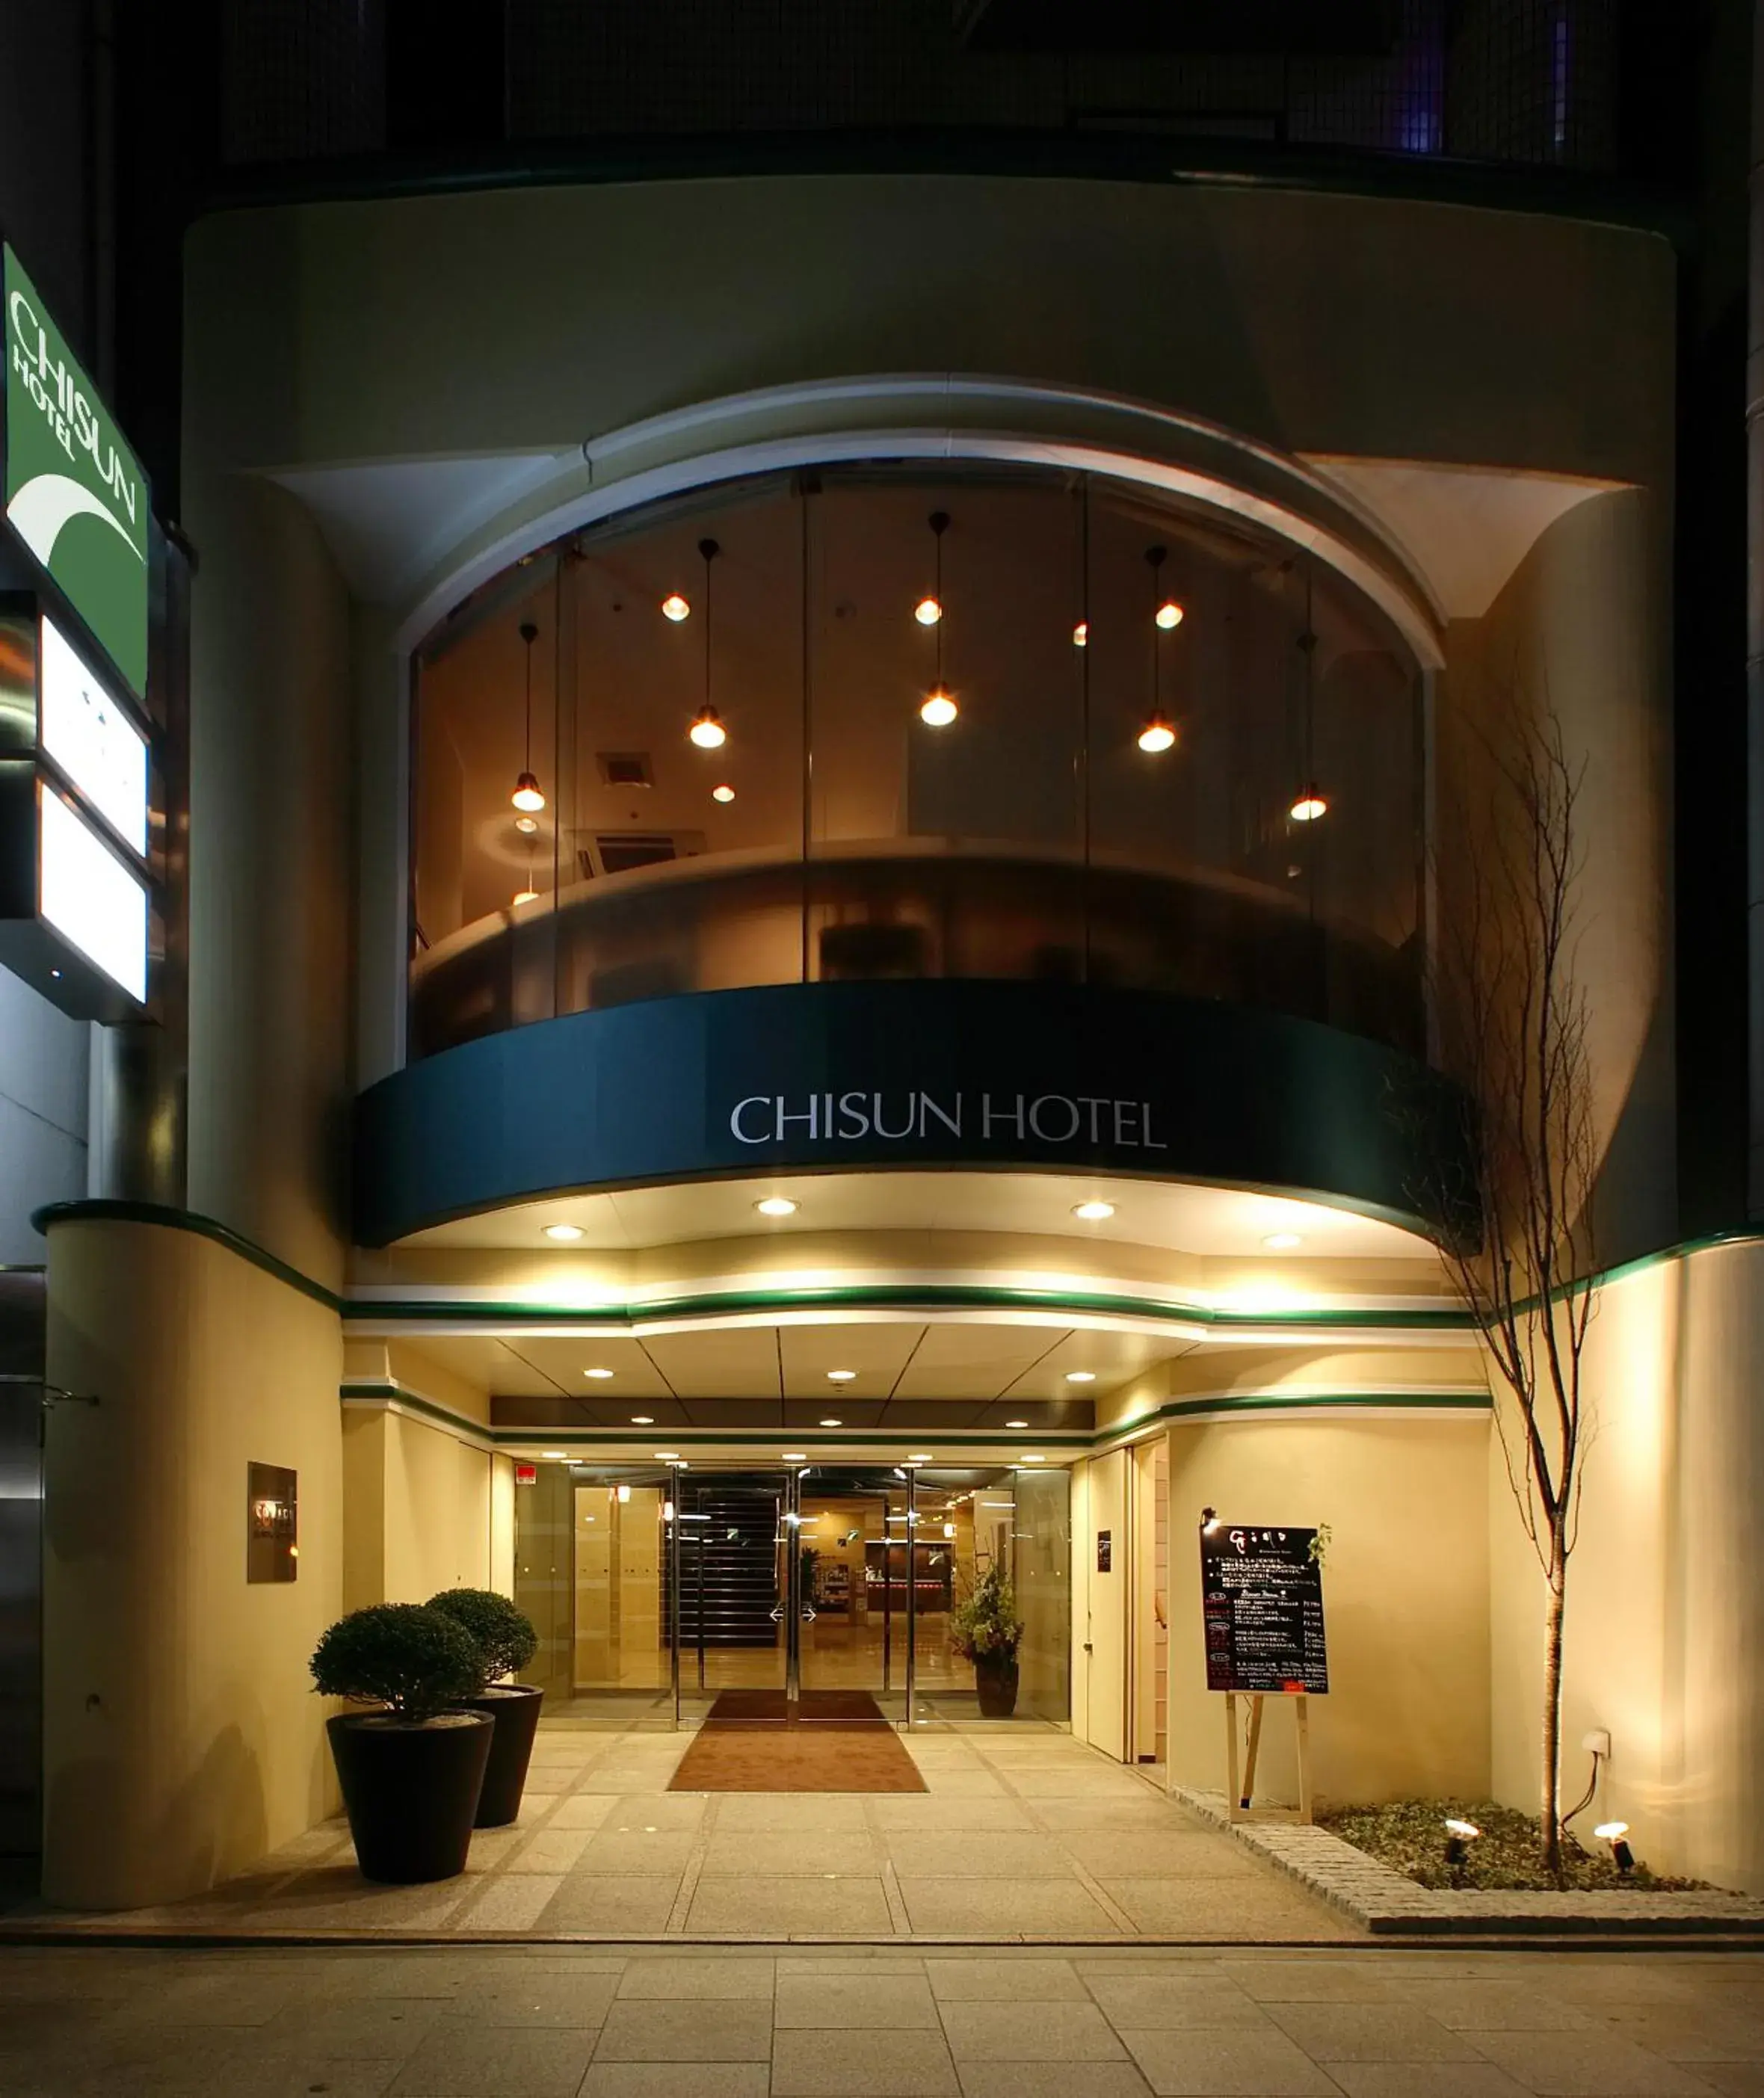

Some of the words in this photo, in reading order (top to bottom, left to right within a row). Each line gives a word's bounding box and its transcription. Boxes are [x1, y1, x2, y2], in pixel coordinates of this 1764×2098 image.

[10, 290, 136, 525] CHISUN
[13, 344, 75, 462] HOTEL
[730, 1091, 961, 1144] CHISUN
[982, 1093, 1168, 1149] HOTEL
